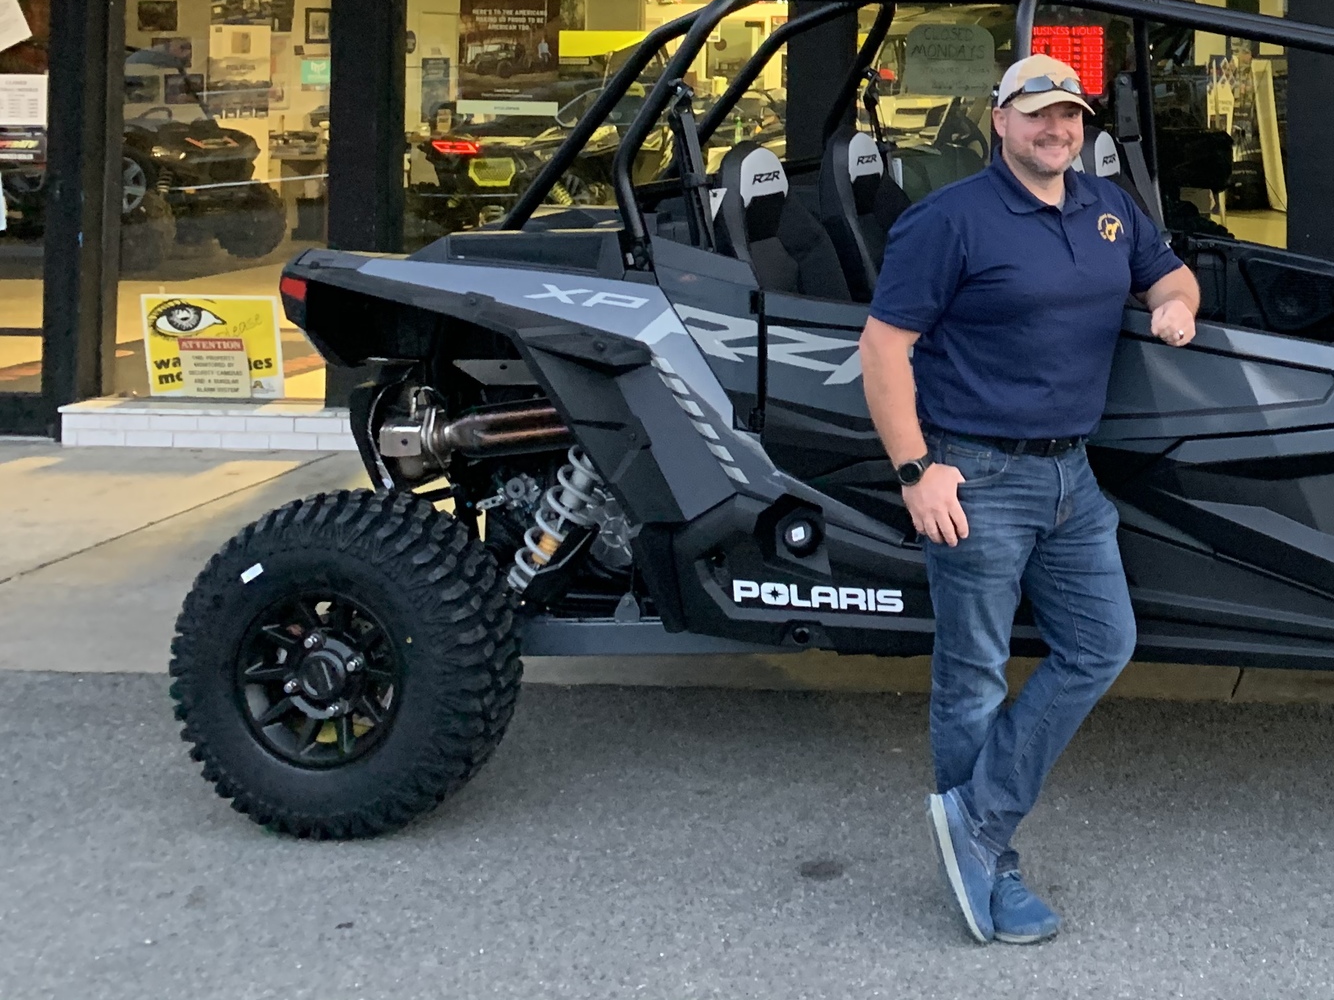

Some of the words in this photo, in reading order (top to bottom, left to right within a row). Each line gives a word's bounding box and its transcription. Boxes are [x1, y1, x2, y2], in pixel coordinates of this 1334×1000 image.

[923, 26, 974, 42] CLOSED
[911, 43, 985, 60] MONDAYS
[856, 153, 878, 166] RZR
[1102, 153, 1117, 167] RZR
[751, 170, 781, 186] RZR
[523, 282, 651, 310] XP
[180, 339, 242, 351] ATTENTION
[673, 302, 864, 386] RZ
[732, 579, 905, 613] POLARIS
